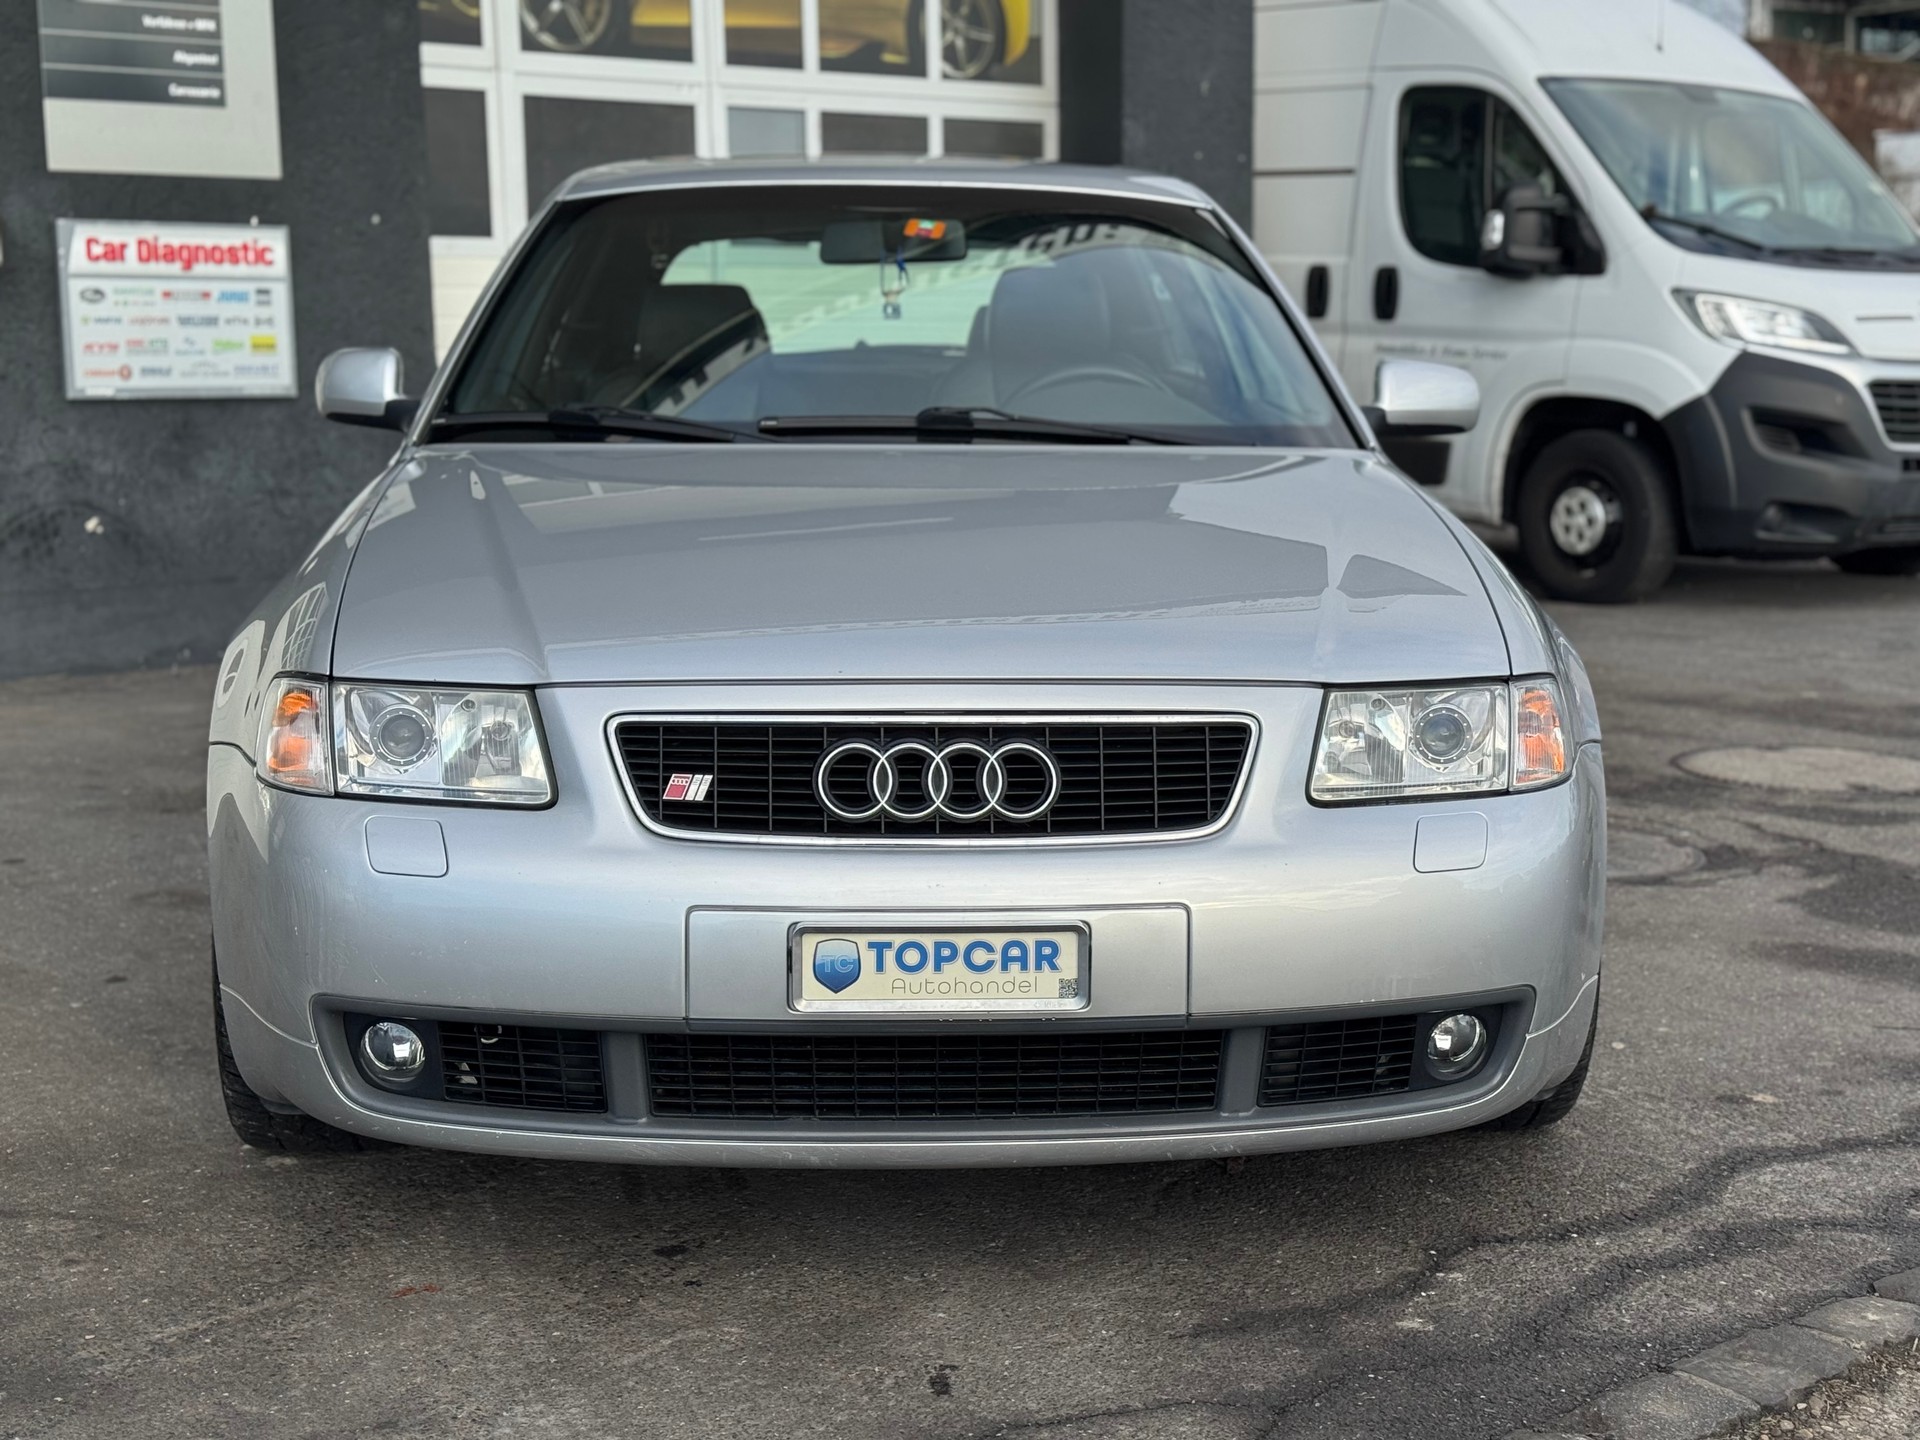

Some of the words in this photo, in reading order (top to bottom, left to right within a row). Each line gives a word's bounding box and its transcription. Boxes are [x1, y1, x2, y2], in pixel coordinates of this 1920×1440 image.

[86, 237, 128, 262] Car
[137, 237, 275, 271] Diagnostic
[820, 954, 855, 973] TC
[866, 939, 1062, 974] TOPCAR
[891, 976, 1038, 995] Autohandel
